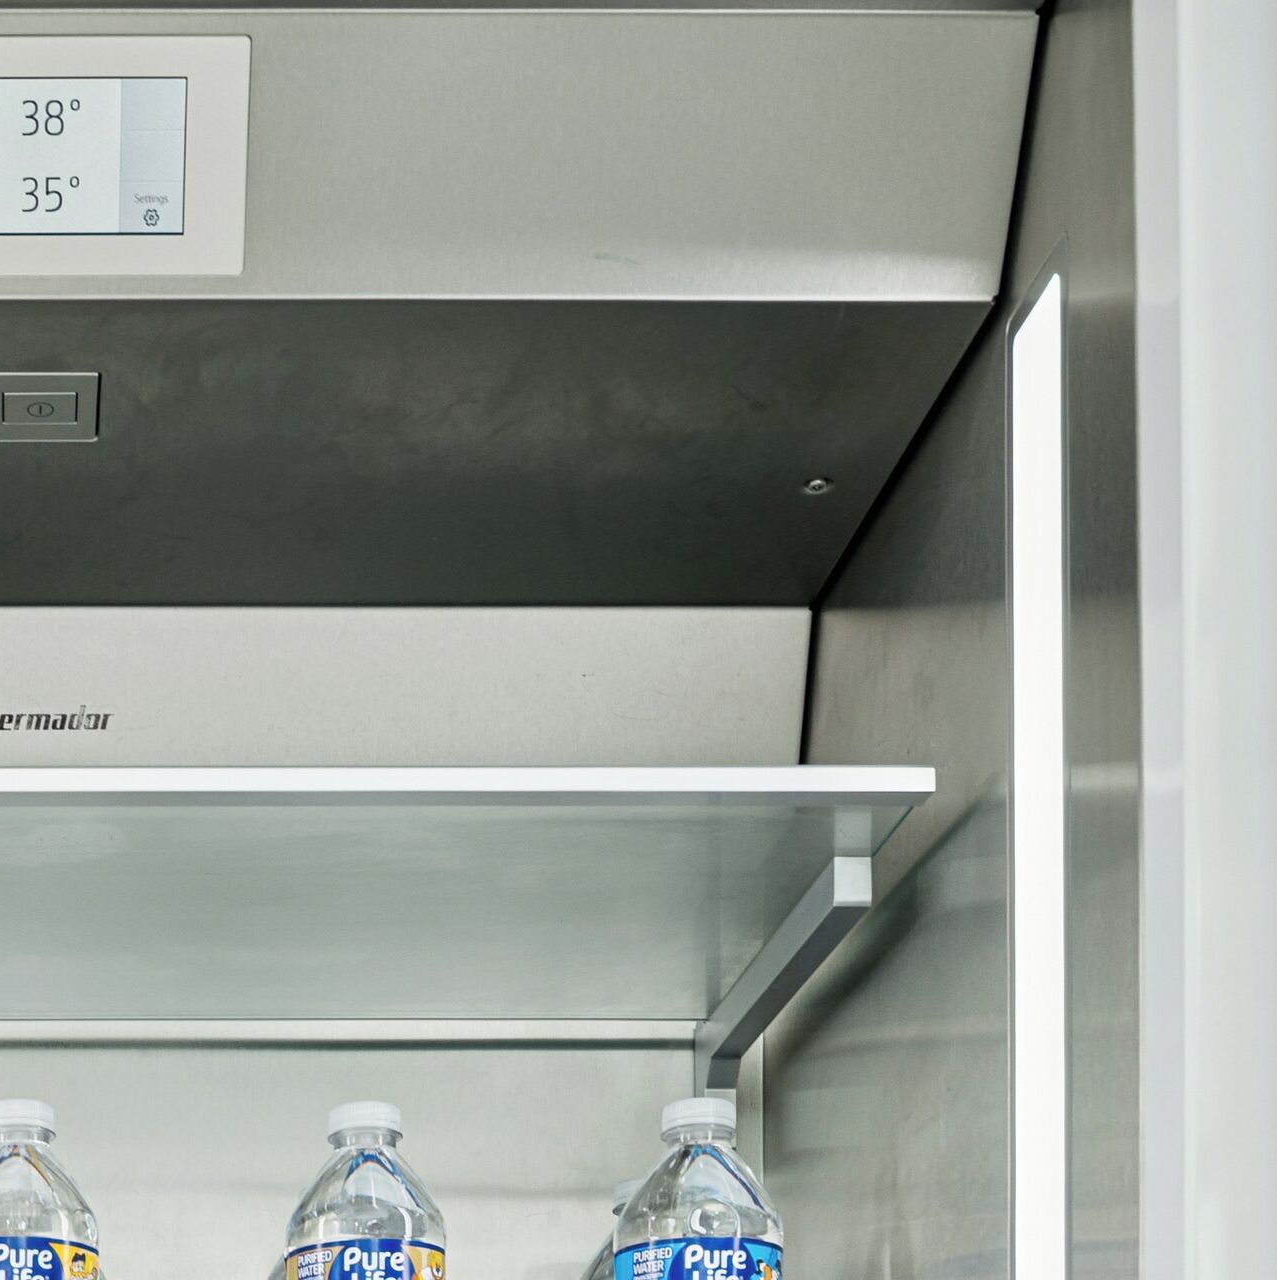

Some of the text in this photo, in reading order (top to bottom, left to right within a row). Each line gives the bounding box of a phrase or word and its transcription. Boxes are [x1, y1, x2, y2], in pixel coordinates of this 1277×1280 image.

[21, 98, 81, 137] 38°
[21, 175, 80, 213] 35°
[134, 193, 169, 205] Settings
[297, 1250, 333, 1267] PURIFIED
[343, 1246, 406, 1273] Pure
[633, 1247, 673, 1264] PURIFIED
[684, 1244, 747, 1271] Pure
[297, 1264, 325, 1279] WATER
[633, 1259, 665, 1276] WATER
